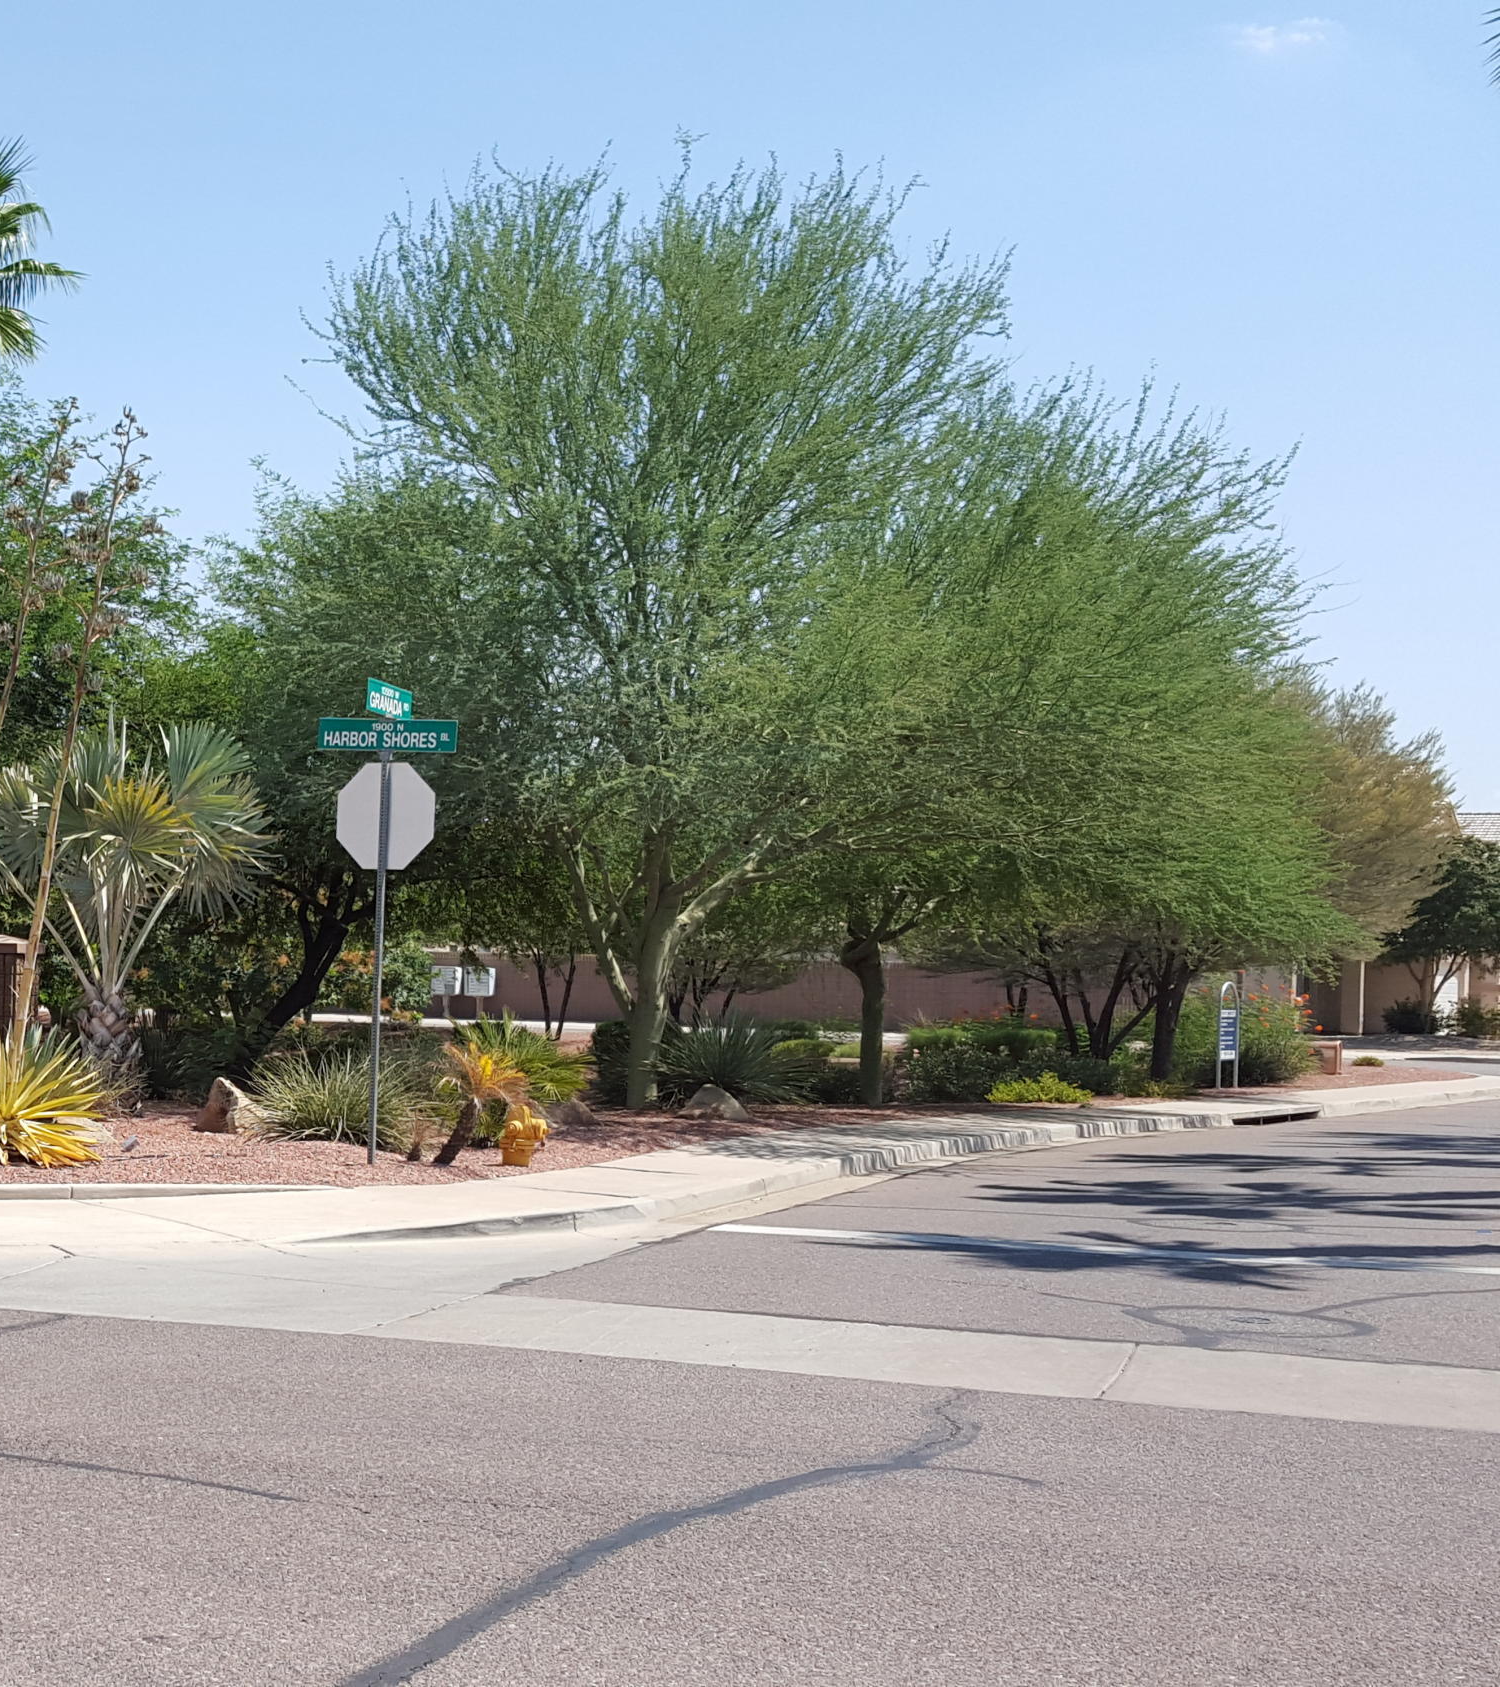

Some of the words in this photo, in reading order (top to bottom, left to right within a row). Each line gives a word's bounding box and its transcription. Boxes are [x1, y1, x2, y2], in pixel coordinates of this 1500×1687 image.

[369, 691, 403, 717] GRANADA
[372, 722, 393, 732] 1900
[397, 723, 404, 731] N
[323, 731, 377, 748] HARBOR
[382, 731, 437, 748] SHORES
[440, 733, 450, 742] BL
